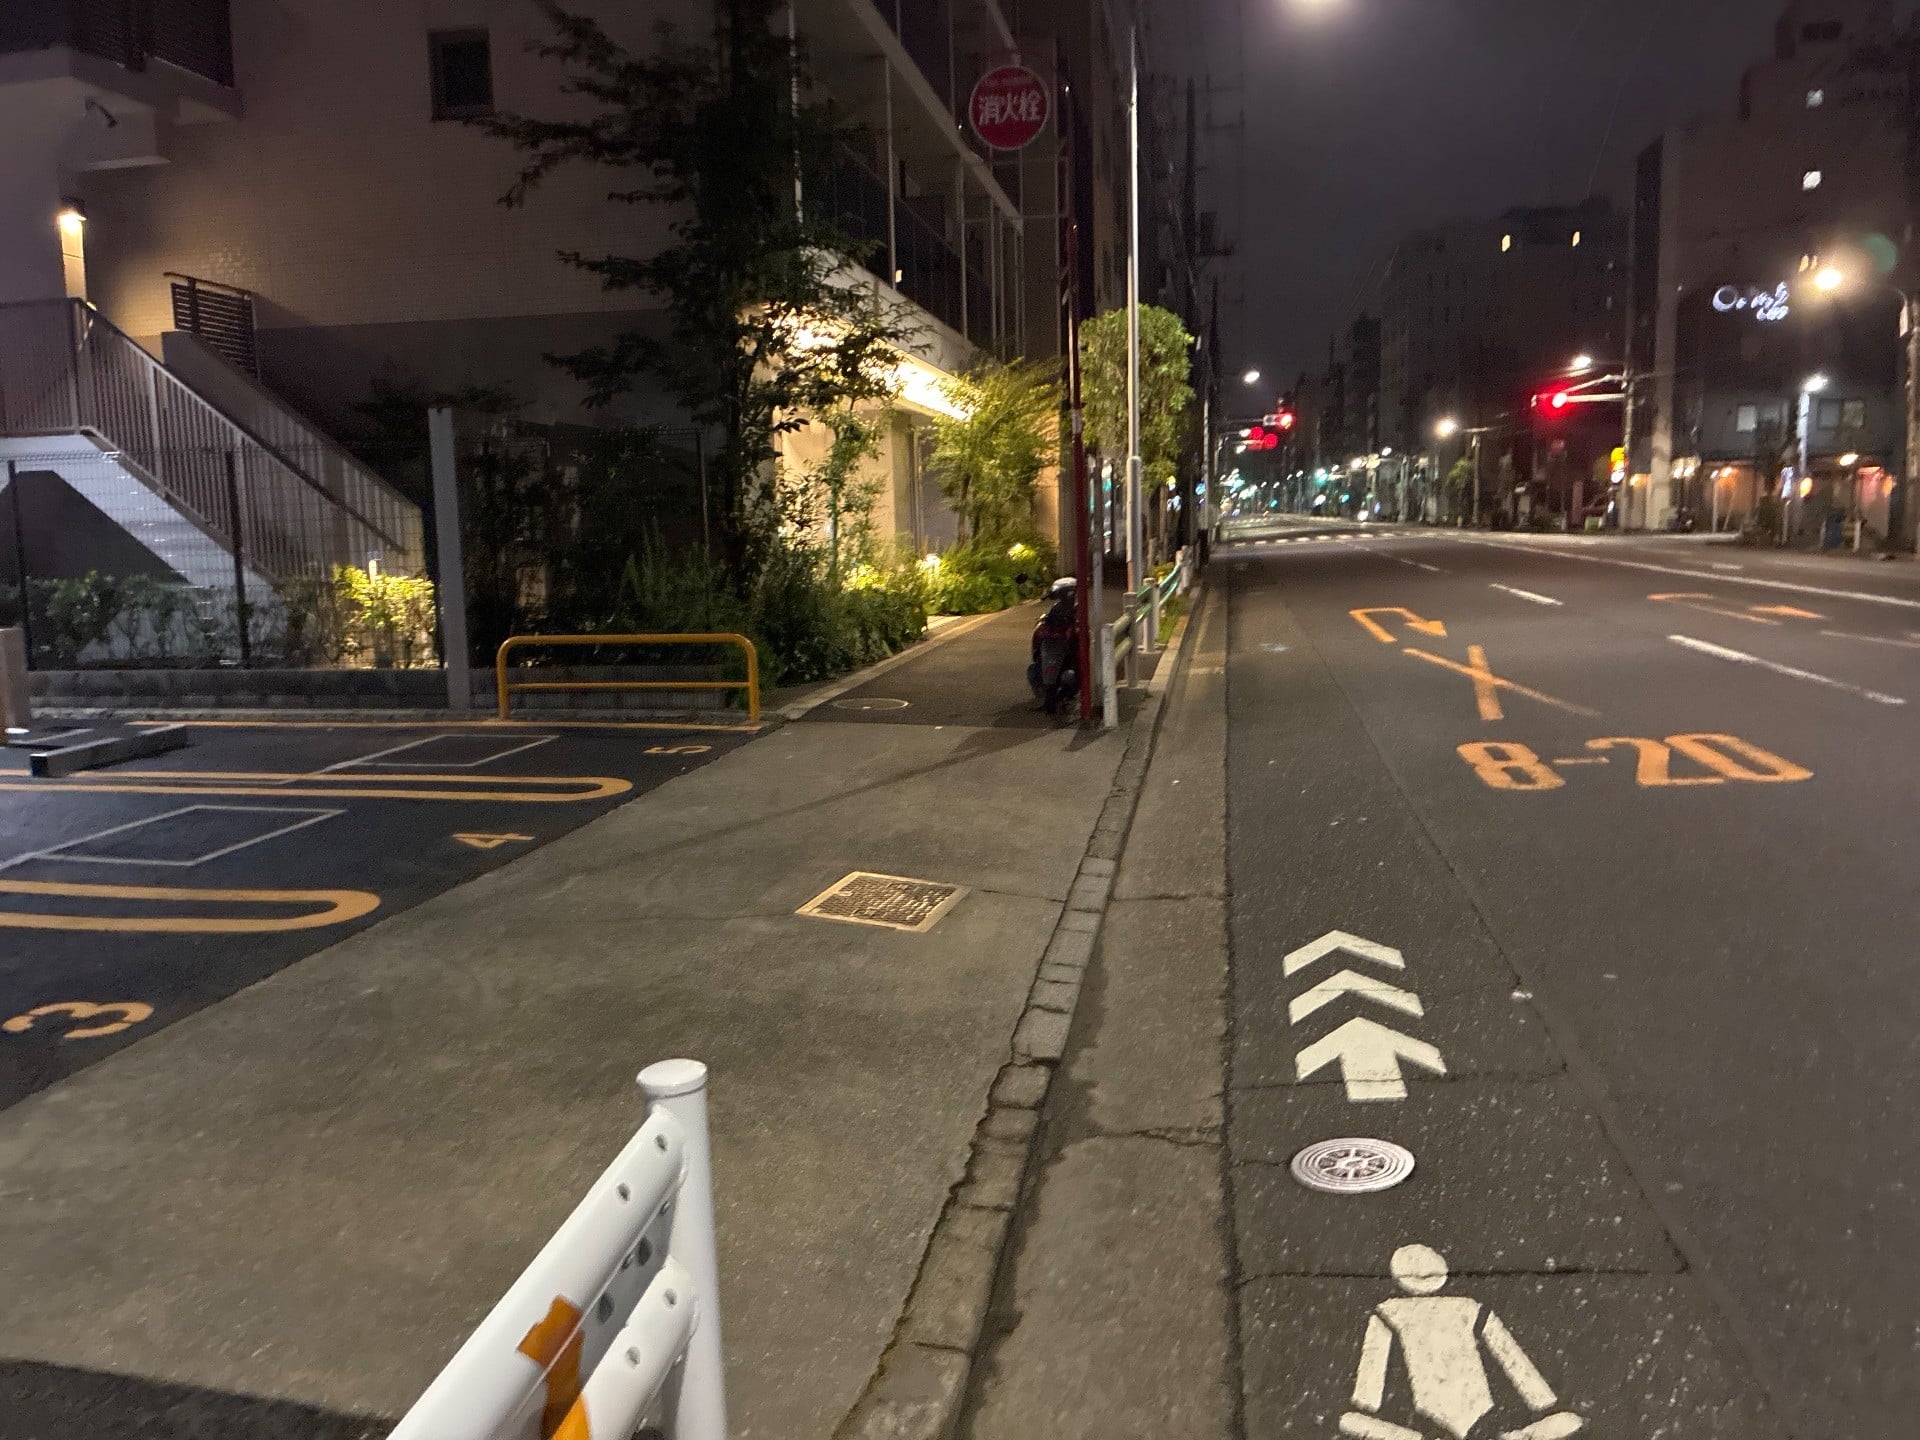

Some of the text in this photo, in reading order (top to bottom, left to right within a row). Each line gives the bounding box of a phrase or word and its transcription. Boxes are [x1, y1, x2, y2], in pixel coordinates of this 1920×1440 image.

[978, 90, 1041, 126] 消火栓
[643, 745, 712, 755] 5
[1457, 733, 1814, 790] 8-20
[452, 833, 535, 849] 4
[3, 1001, 154, 1040] 3
